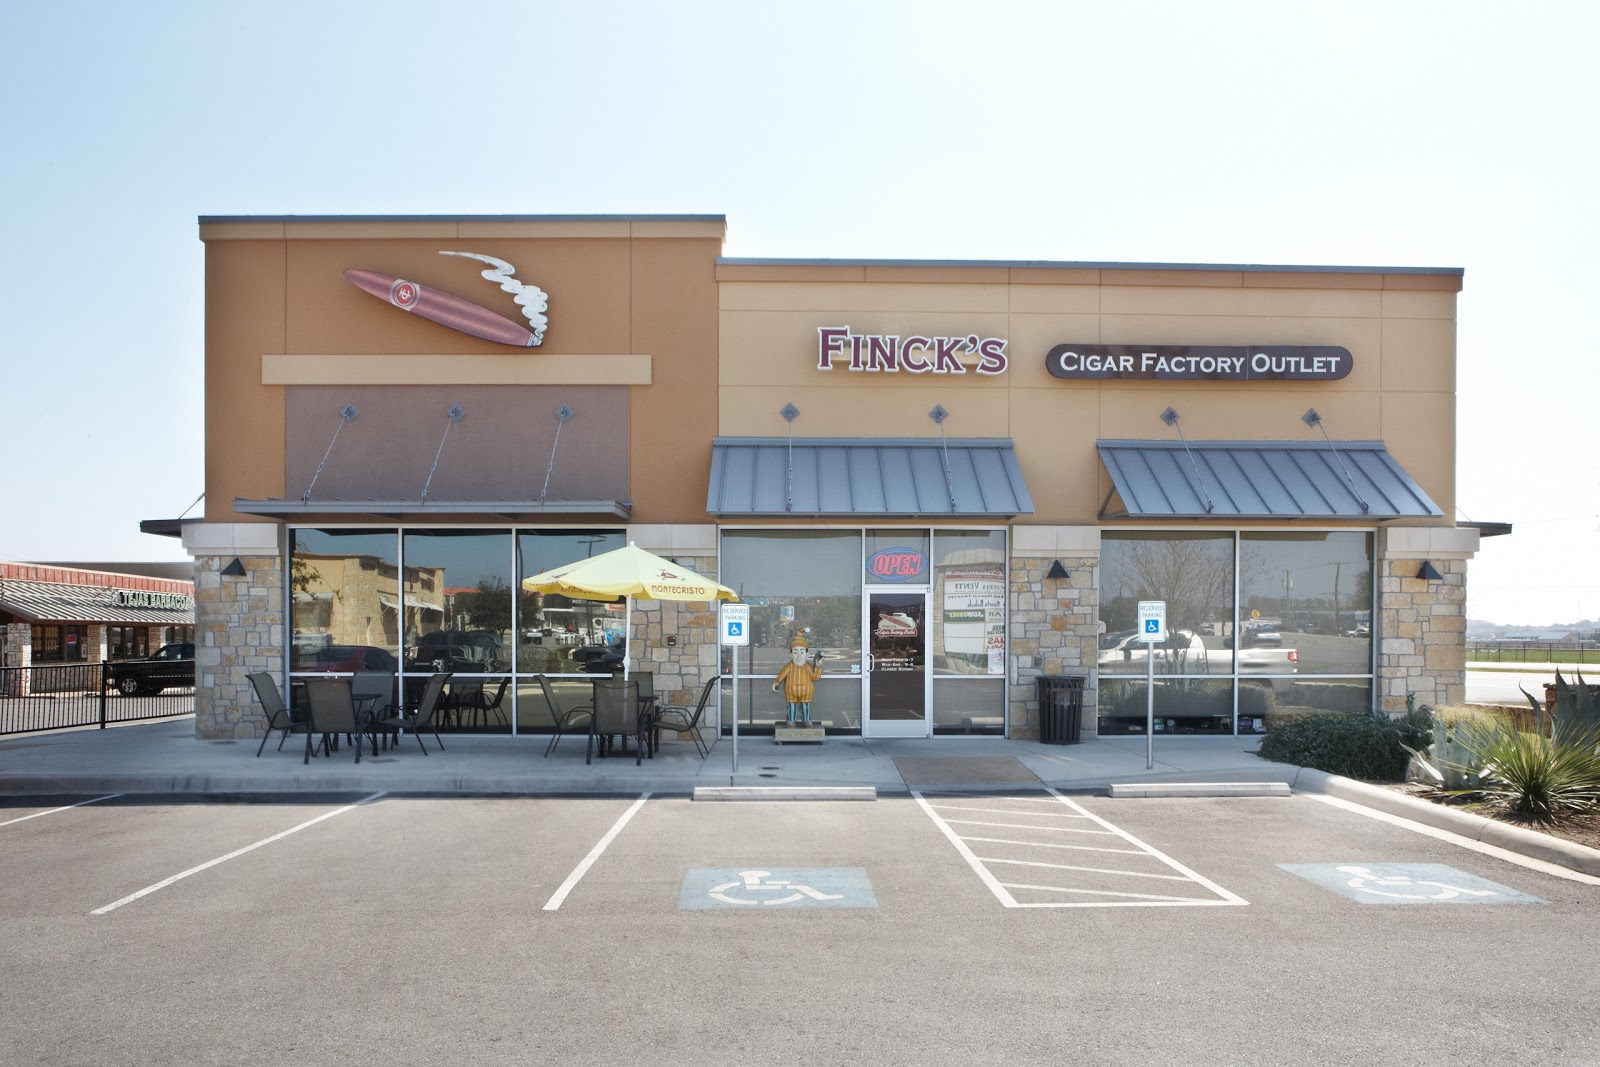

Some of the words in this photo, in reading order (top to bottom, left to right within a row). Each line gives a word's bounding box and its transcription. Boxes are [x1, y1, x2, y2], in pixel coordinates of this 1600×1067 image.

[817, 325, 1008, 375] FINCK'S
[1060, 351, 1134, 371] CIGAR
[1140, 352, 1245, 373] FACTORY
[1251, 353, 1340, 373] OUTLET
[873, 554, 921, 575] OPEN
[122, 591, 150, 607] TEJAS
[650, 584, 705, 595] MONTECRISTO
